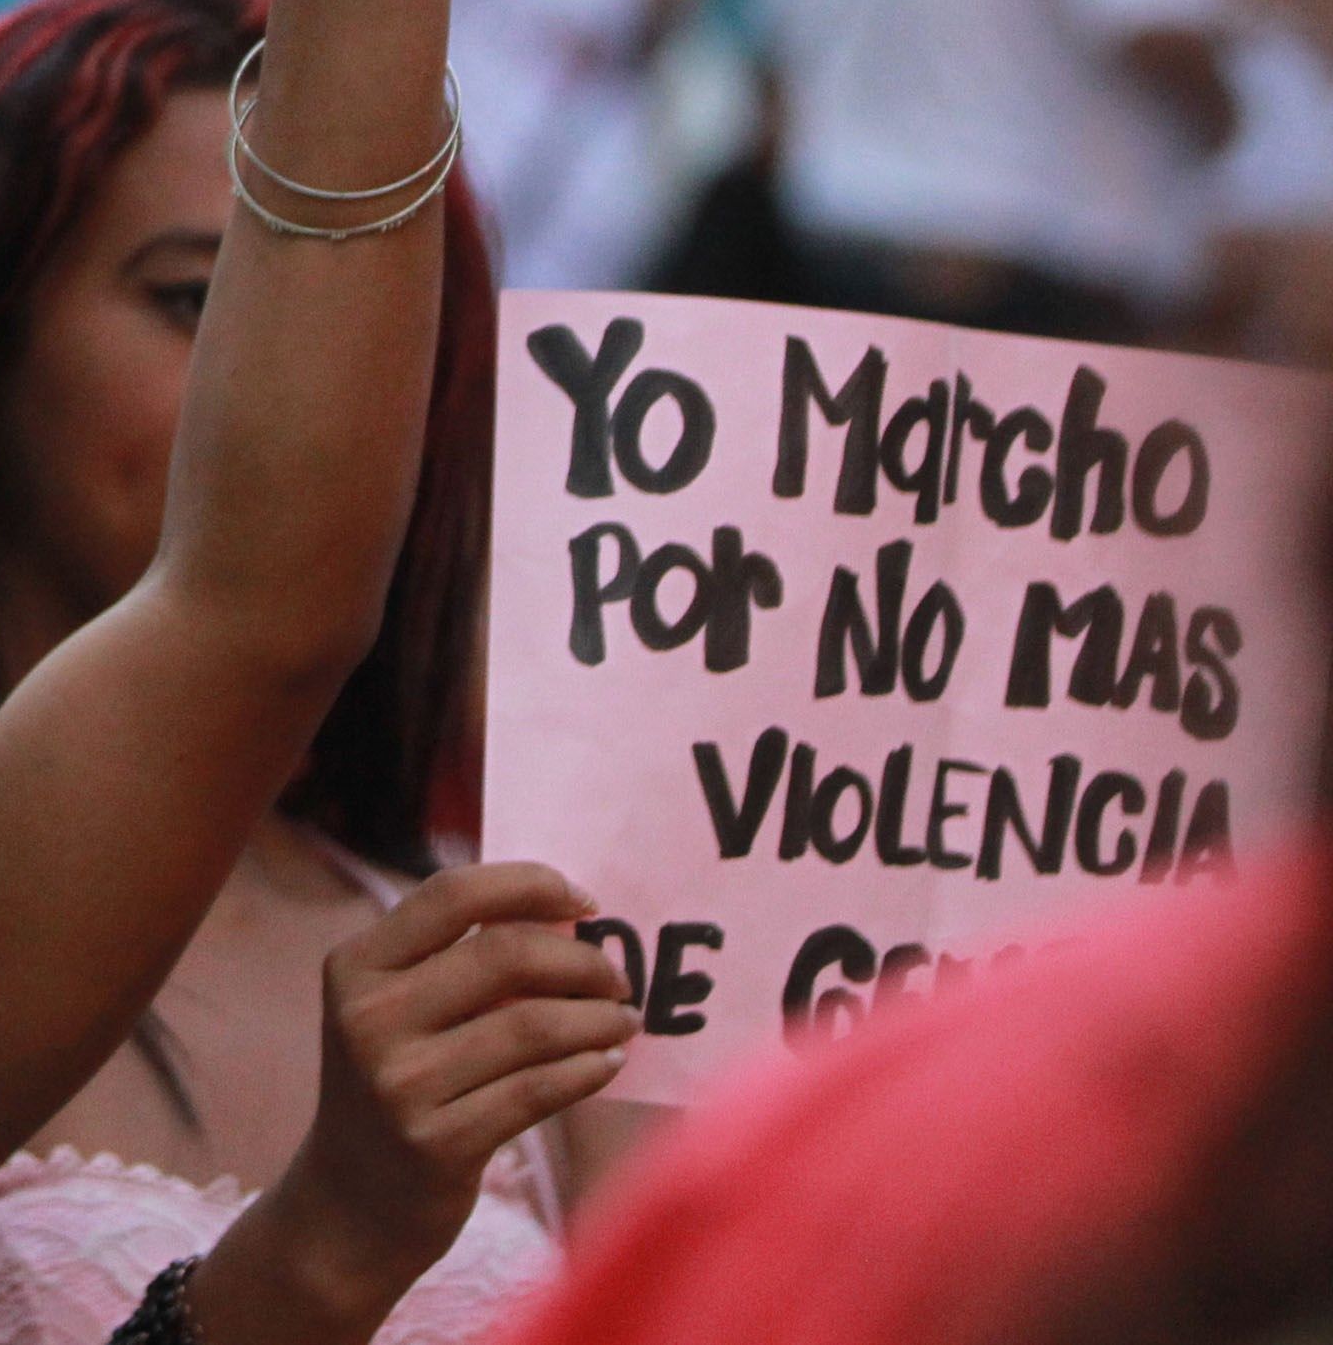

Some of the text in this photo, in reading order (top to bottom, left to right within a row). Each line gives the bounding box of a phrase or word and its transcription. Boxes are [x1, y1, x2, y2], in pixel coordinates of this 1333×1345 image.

[771, 334, 1212, 542] Marcho
[1003, 580, 1244, 742] MAS
[691, 725, 1237, 887] VIOLENCIA
